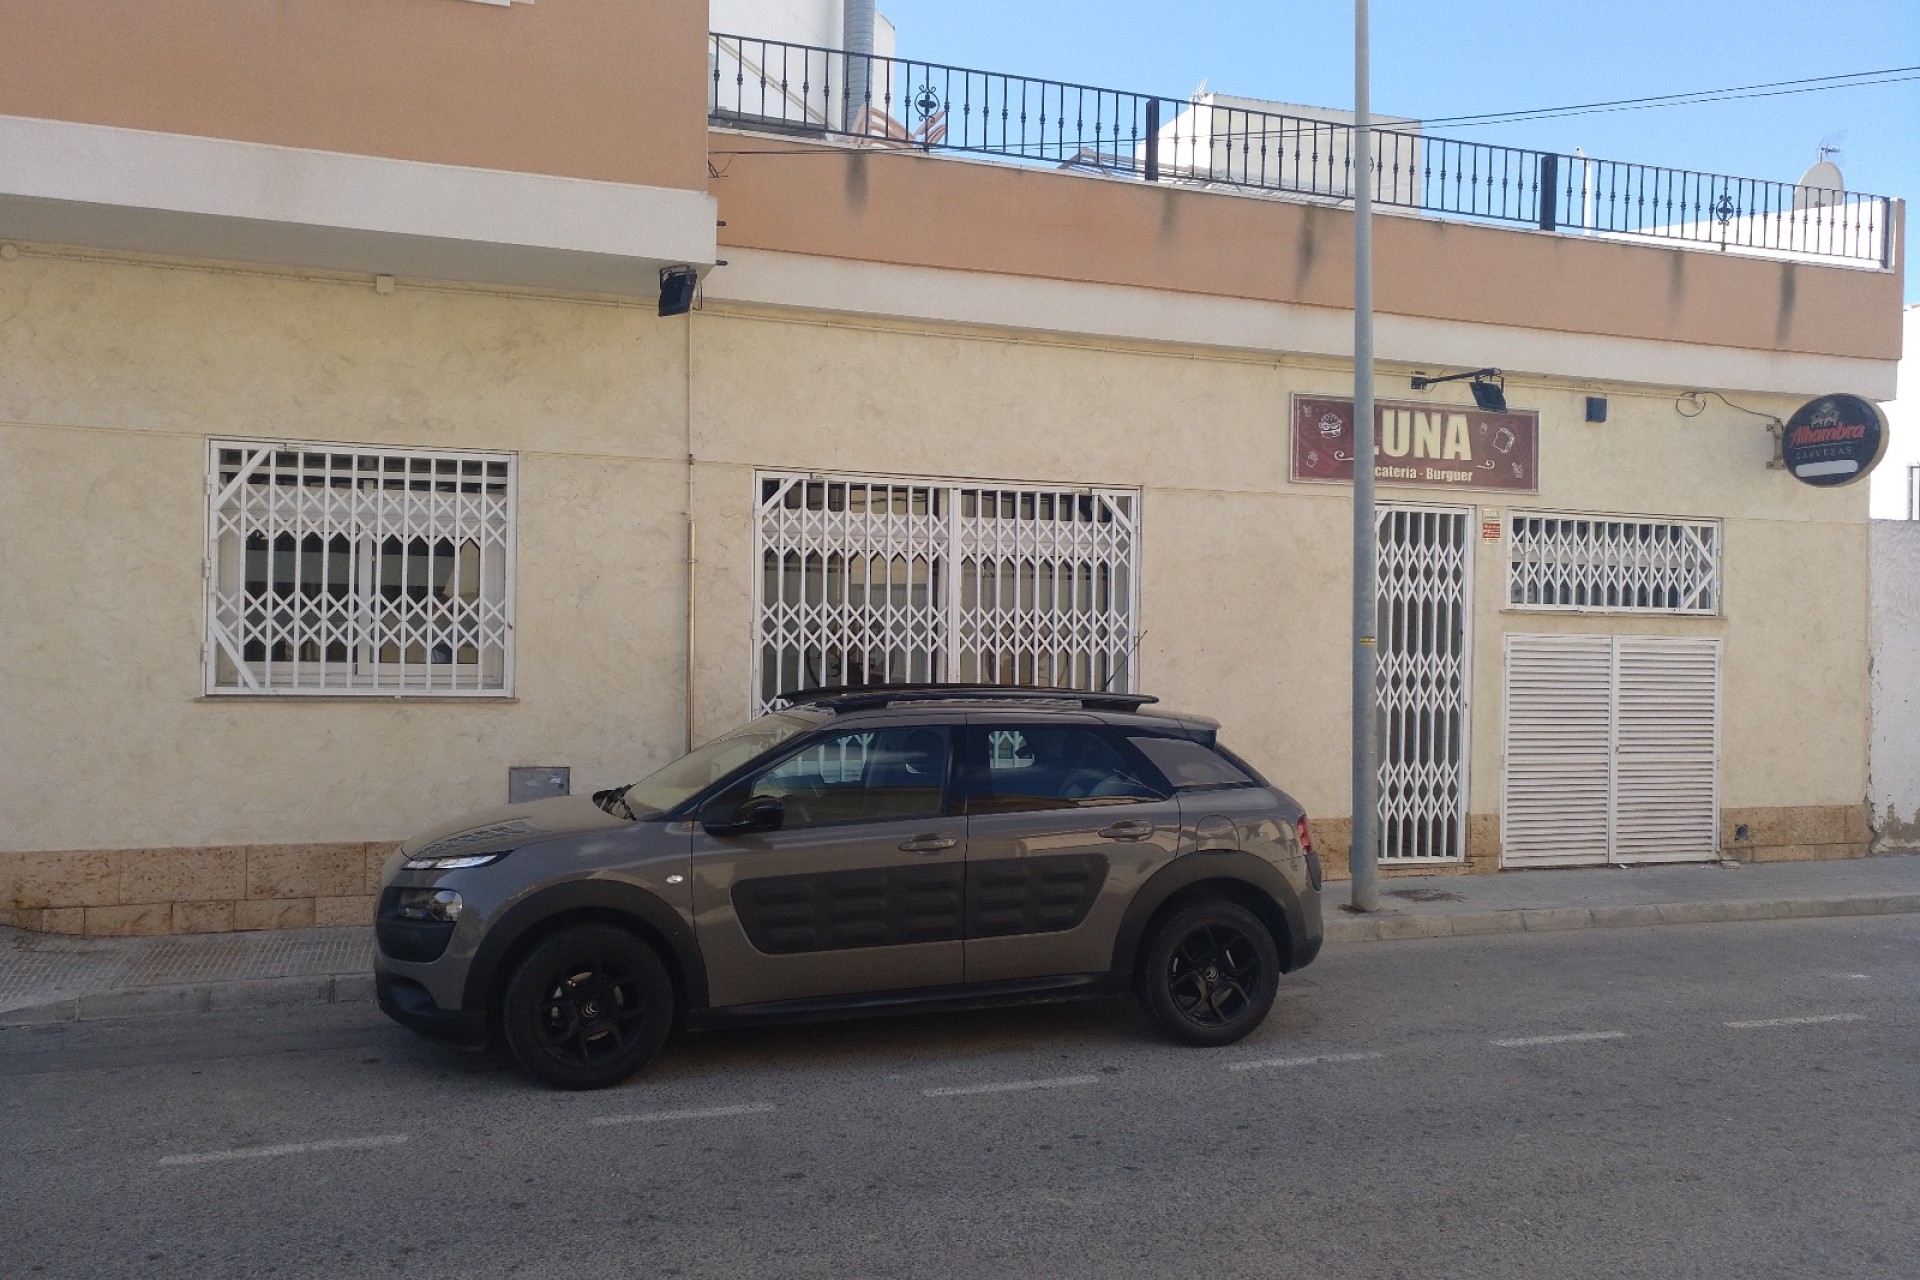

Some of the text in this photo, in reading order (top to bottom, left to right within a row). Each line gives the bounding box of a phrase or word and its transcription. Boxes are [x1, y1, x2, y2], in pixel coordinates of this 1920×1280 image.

[1374, 409, 1472, 460] UNA
[1789, 422, 1866, 448] Alhambra
[1796, 447, 1852, 460] CERVEZAS
[1426, 467, 1473, 482] Burguer
